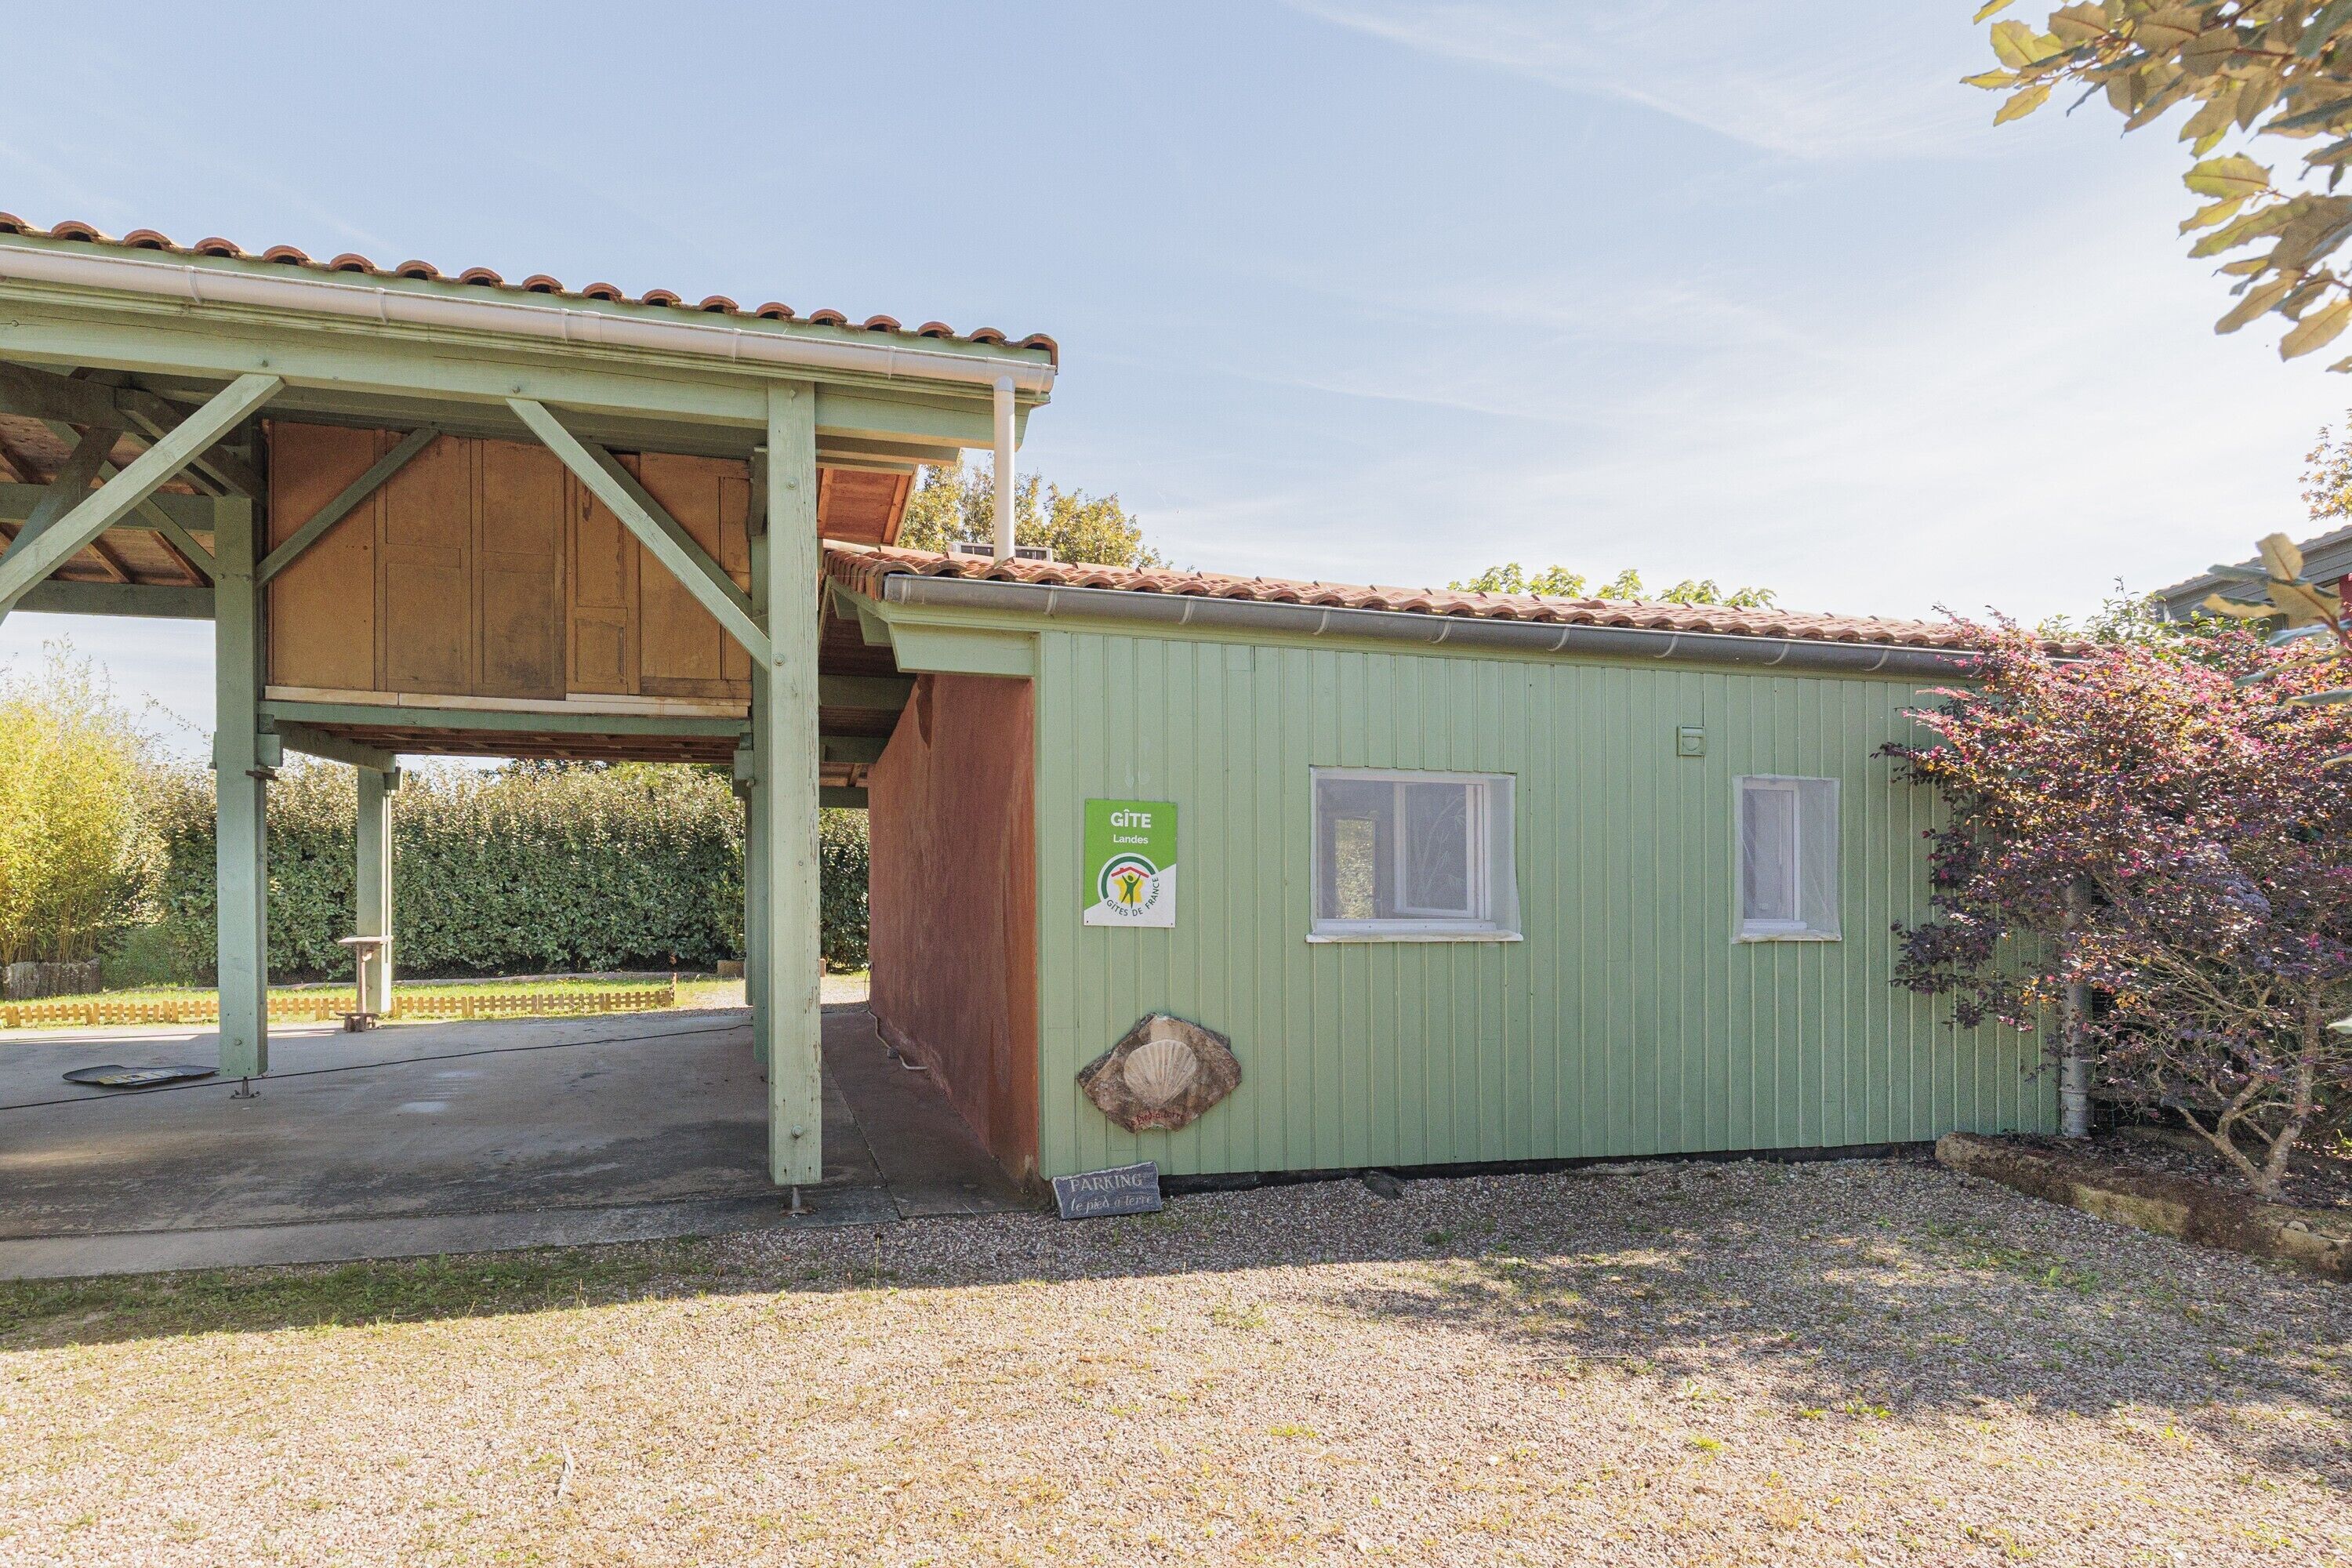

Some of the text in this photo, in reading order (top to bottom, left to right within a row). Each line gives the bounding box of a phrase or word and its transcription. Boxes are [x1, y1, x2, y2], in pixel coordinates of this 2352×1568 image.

[1110, 808, 1152, 828] GÎTE
[1113, 834, 1149, 844] Landes
[1106, 877, 1159, 916] GÎTES DE FRANCE
[1070, 1174, 1142, 1192] PARKING
[1071, 1197, 1083, 1211] le
[1086, 1196, 1109, 1214] pied
[1123, 1196, 1153, 1207] terre
